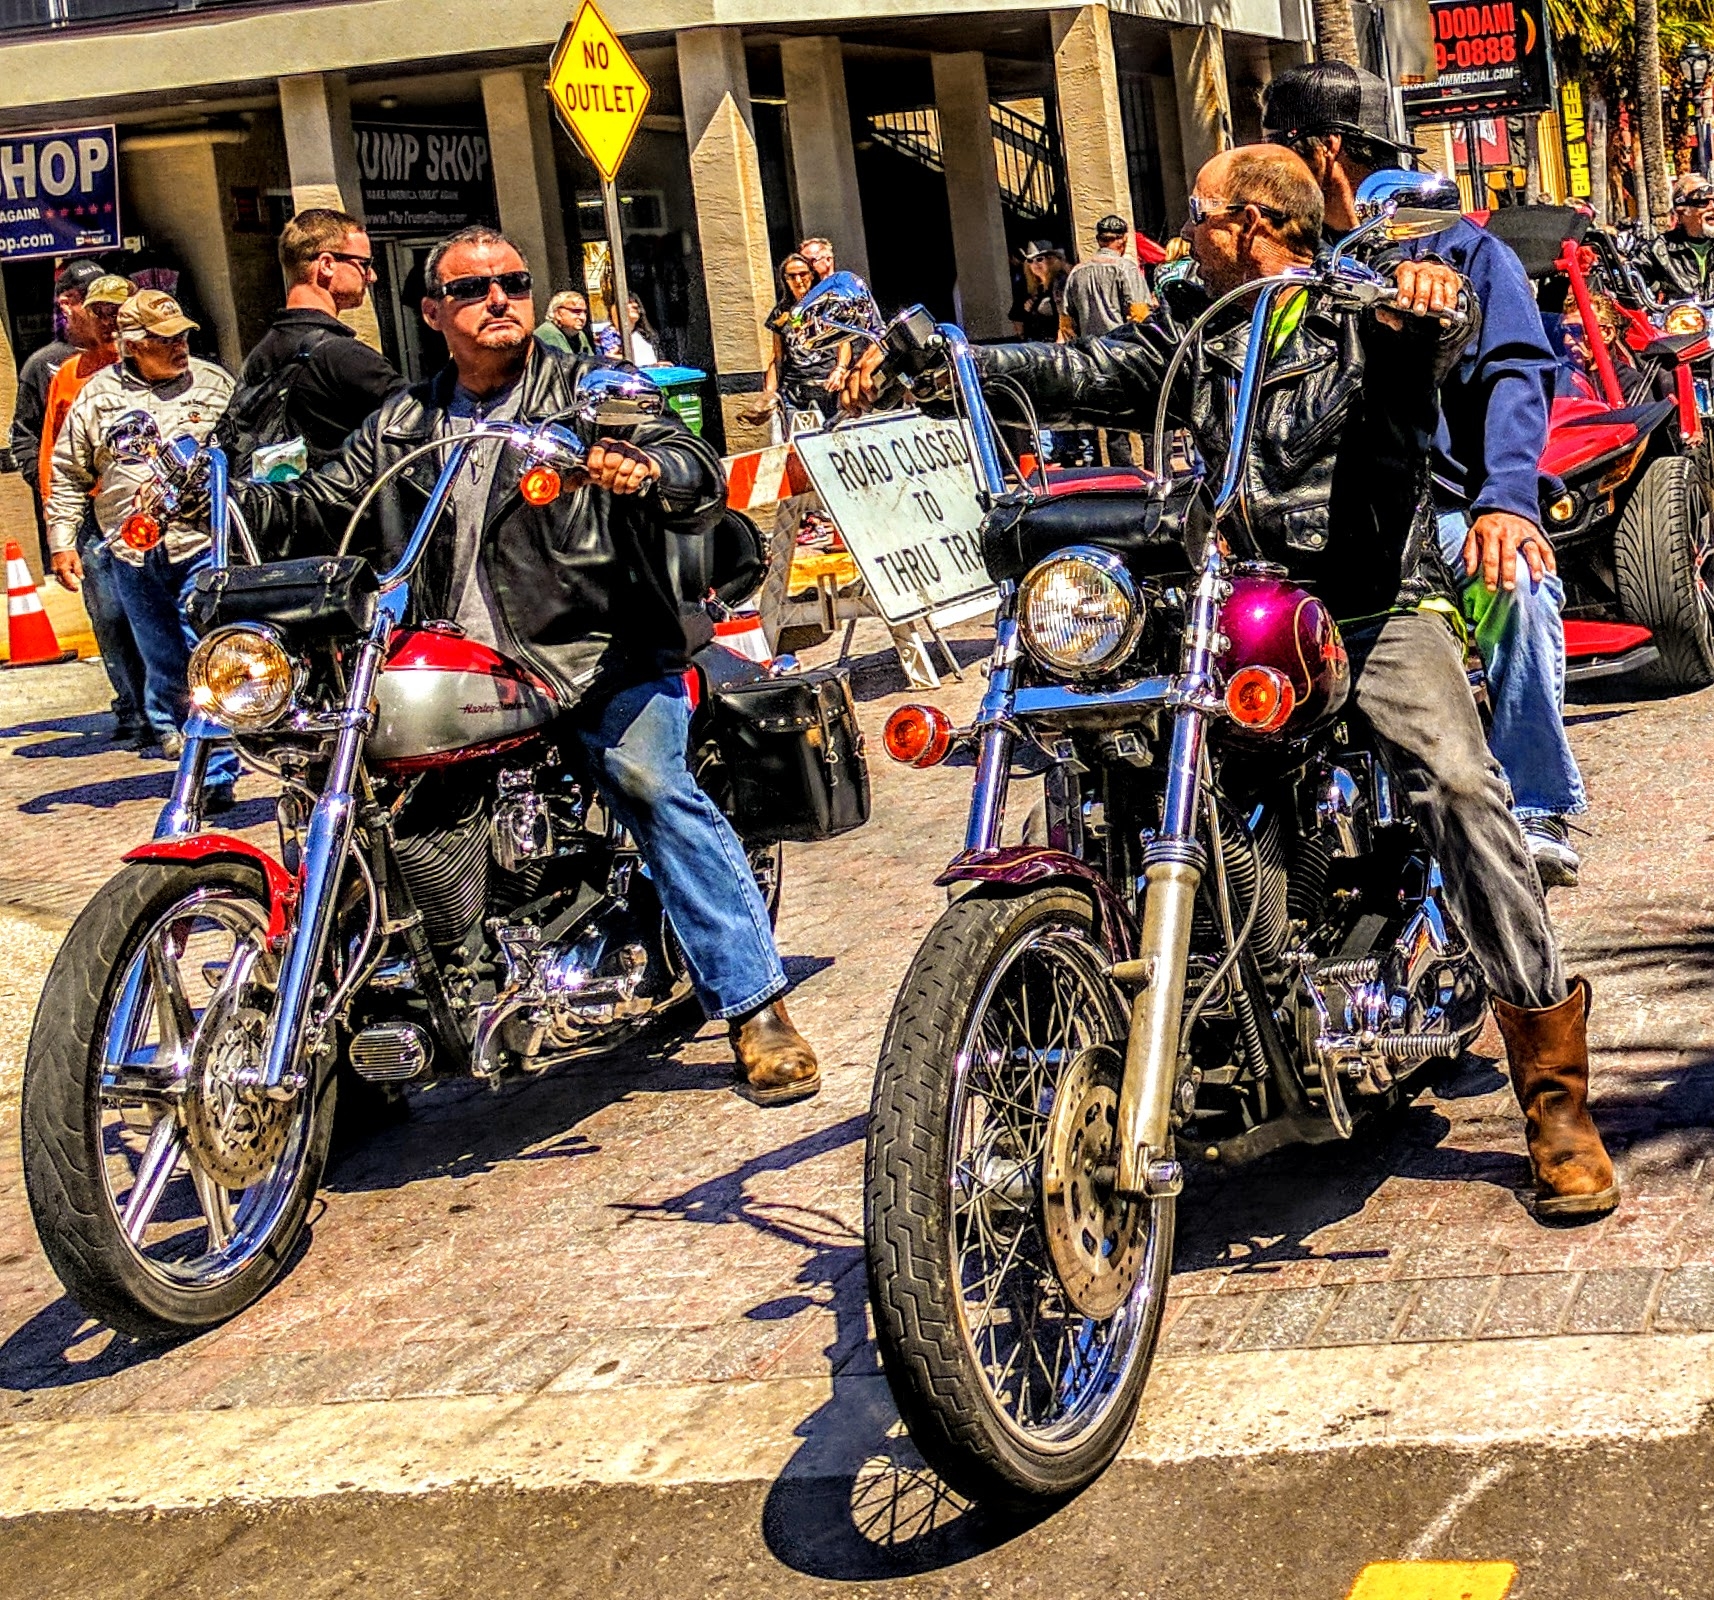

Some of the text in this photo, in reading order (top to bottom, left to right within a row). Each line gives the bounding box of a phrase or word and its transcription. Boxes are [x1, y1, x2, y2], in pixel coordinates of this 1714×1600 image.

[1438, 2, 1515, 40] DODANI
[583, 40, 609, 70] NO
[1435, 35, 1516, 71] 9-0888
[565, 82, 635, 113] OUTLET
[0, 136, 110, 201] HOP
[425, 134, 488, 182] SHOP
[1567, 141, 1591, 197] BIKE
[0, 206, 41, 224] AGAIN!
[828, 428, 969, 492] ROAD CLOSED
[912, 489, 944, 524] TO
[874, 543, 942, 596] THRU
